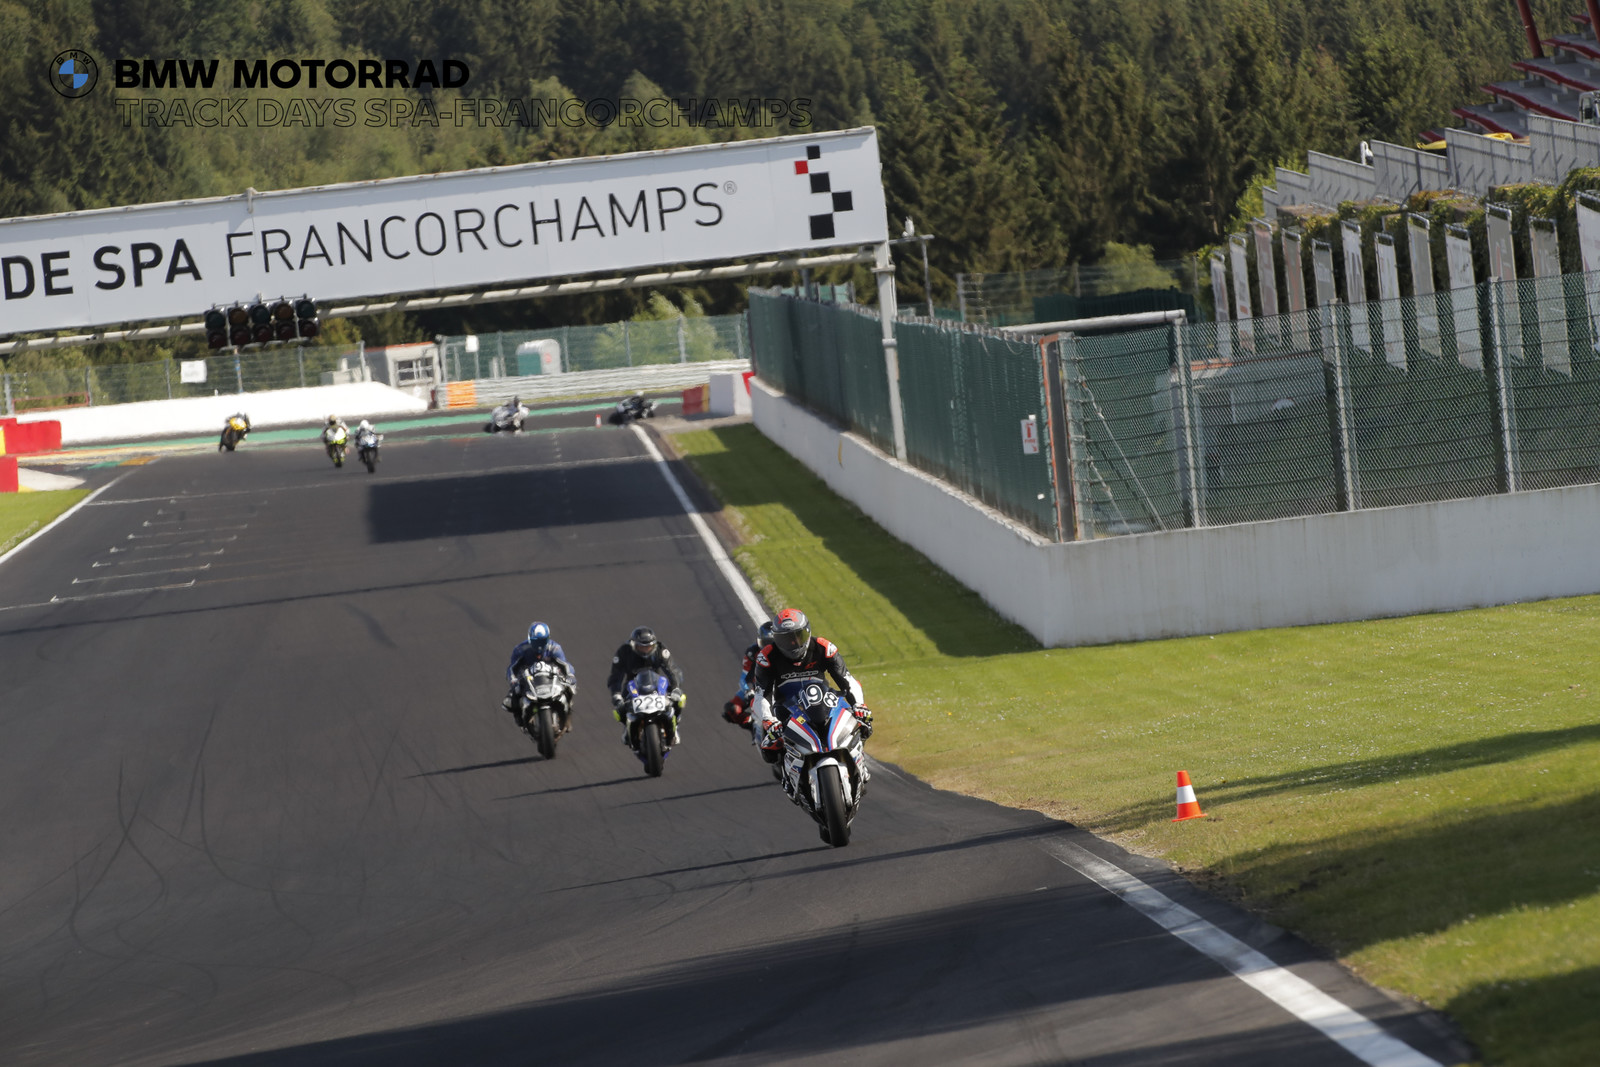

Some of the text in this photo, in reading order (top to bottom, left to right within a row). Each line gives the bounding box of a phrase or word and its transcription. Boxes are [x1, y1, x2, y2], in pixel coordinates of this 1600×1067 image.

[1, 250, 74, 300] DE
[93, 238, 203, 290] SPA
[633, 696, 664, 711] 228
